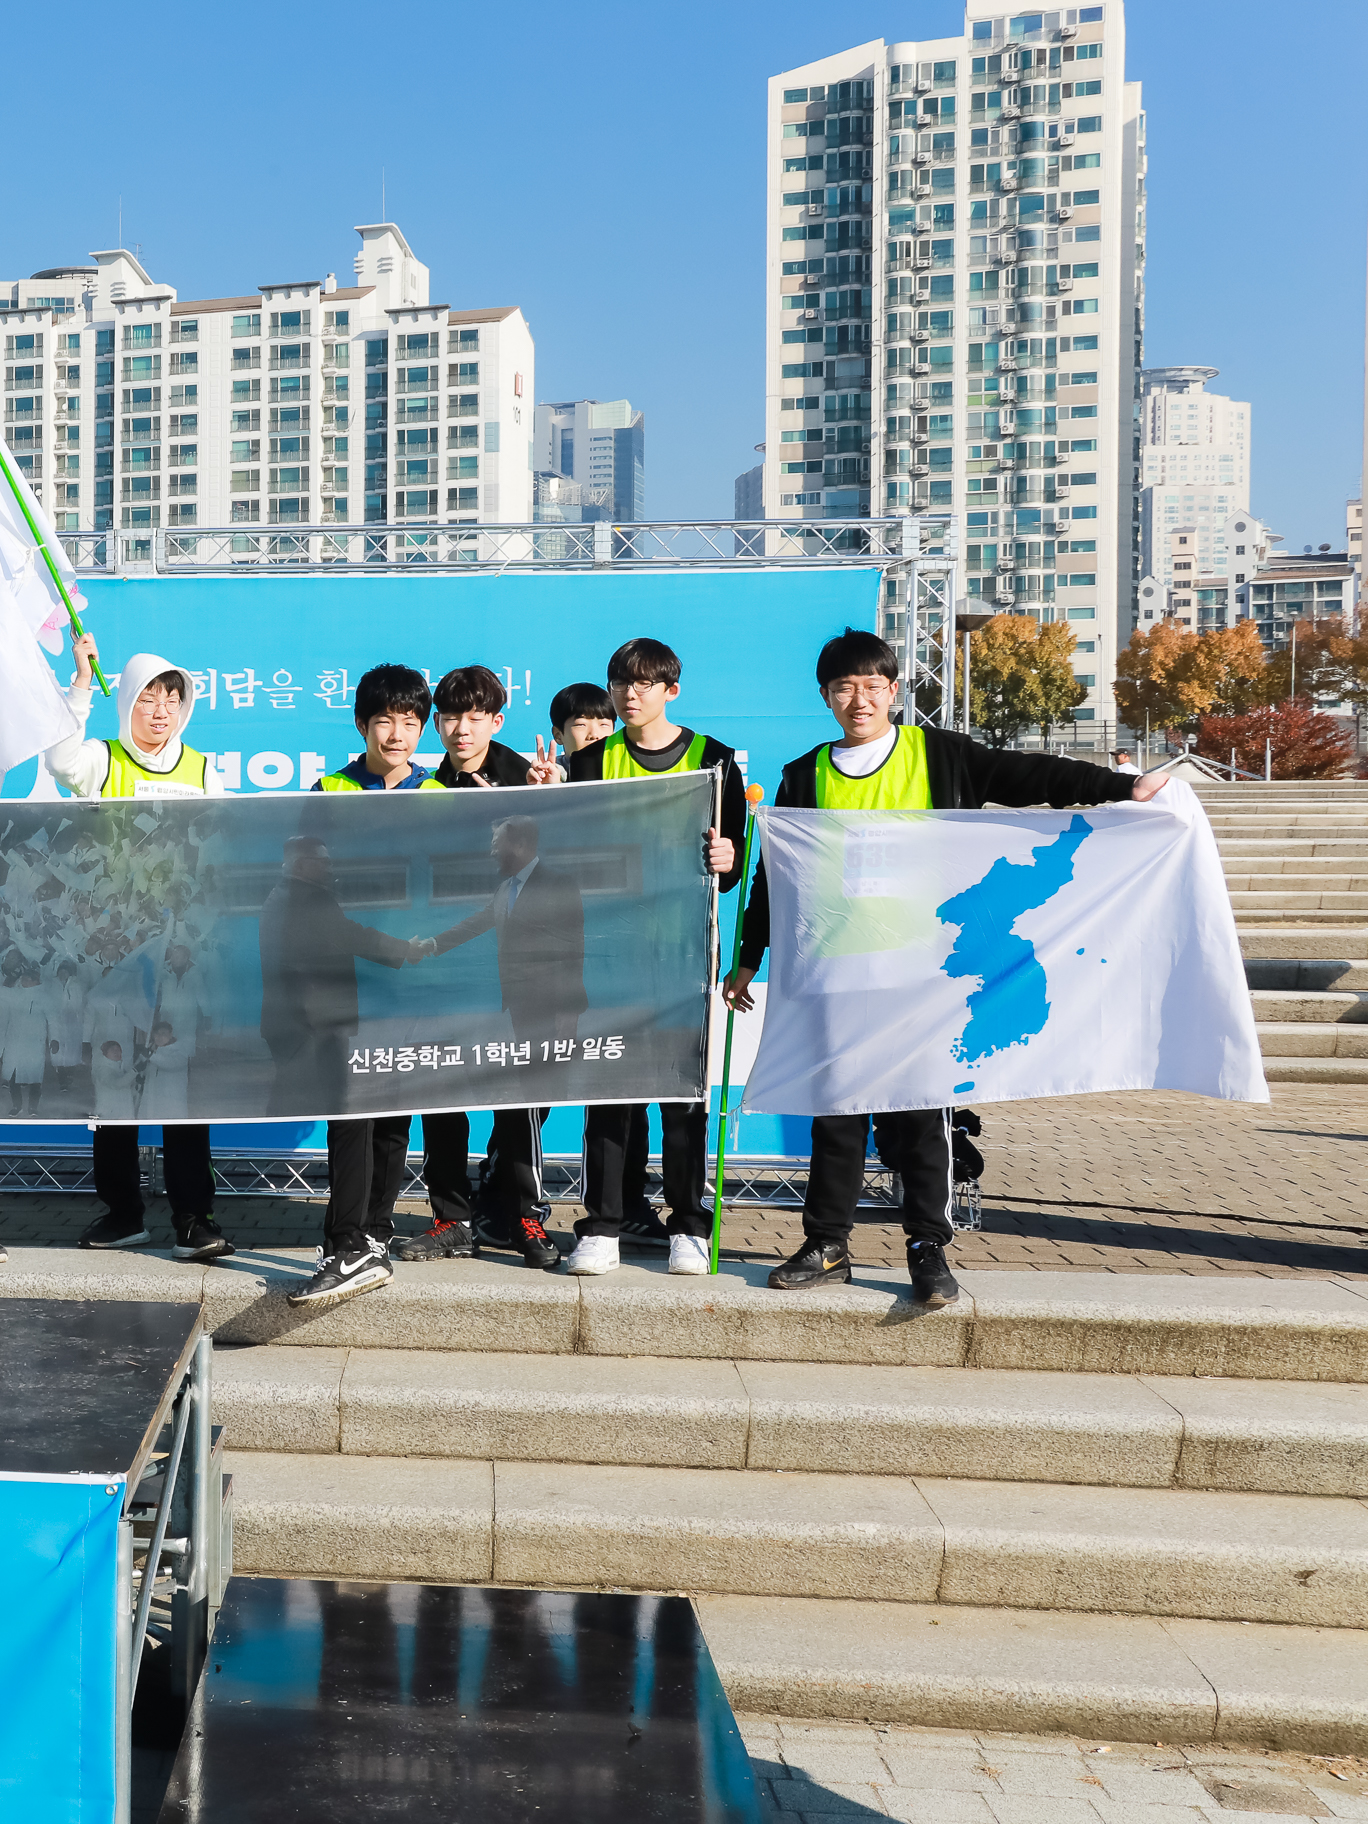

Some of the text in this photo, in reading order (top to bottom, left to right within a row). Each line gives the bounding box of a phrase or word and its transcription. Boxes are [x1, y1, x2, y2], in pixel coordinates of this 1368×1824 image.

[347, 1035, 627, 1074] 신천중학교 1학년 1반 일동
